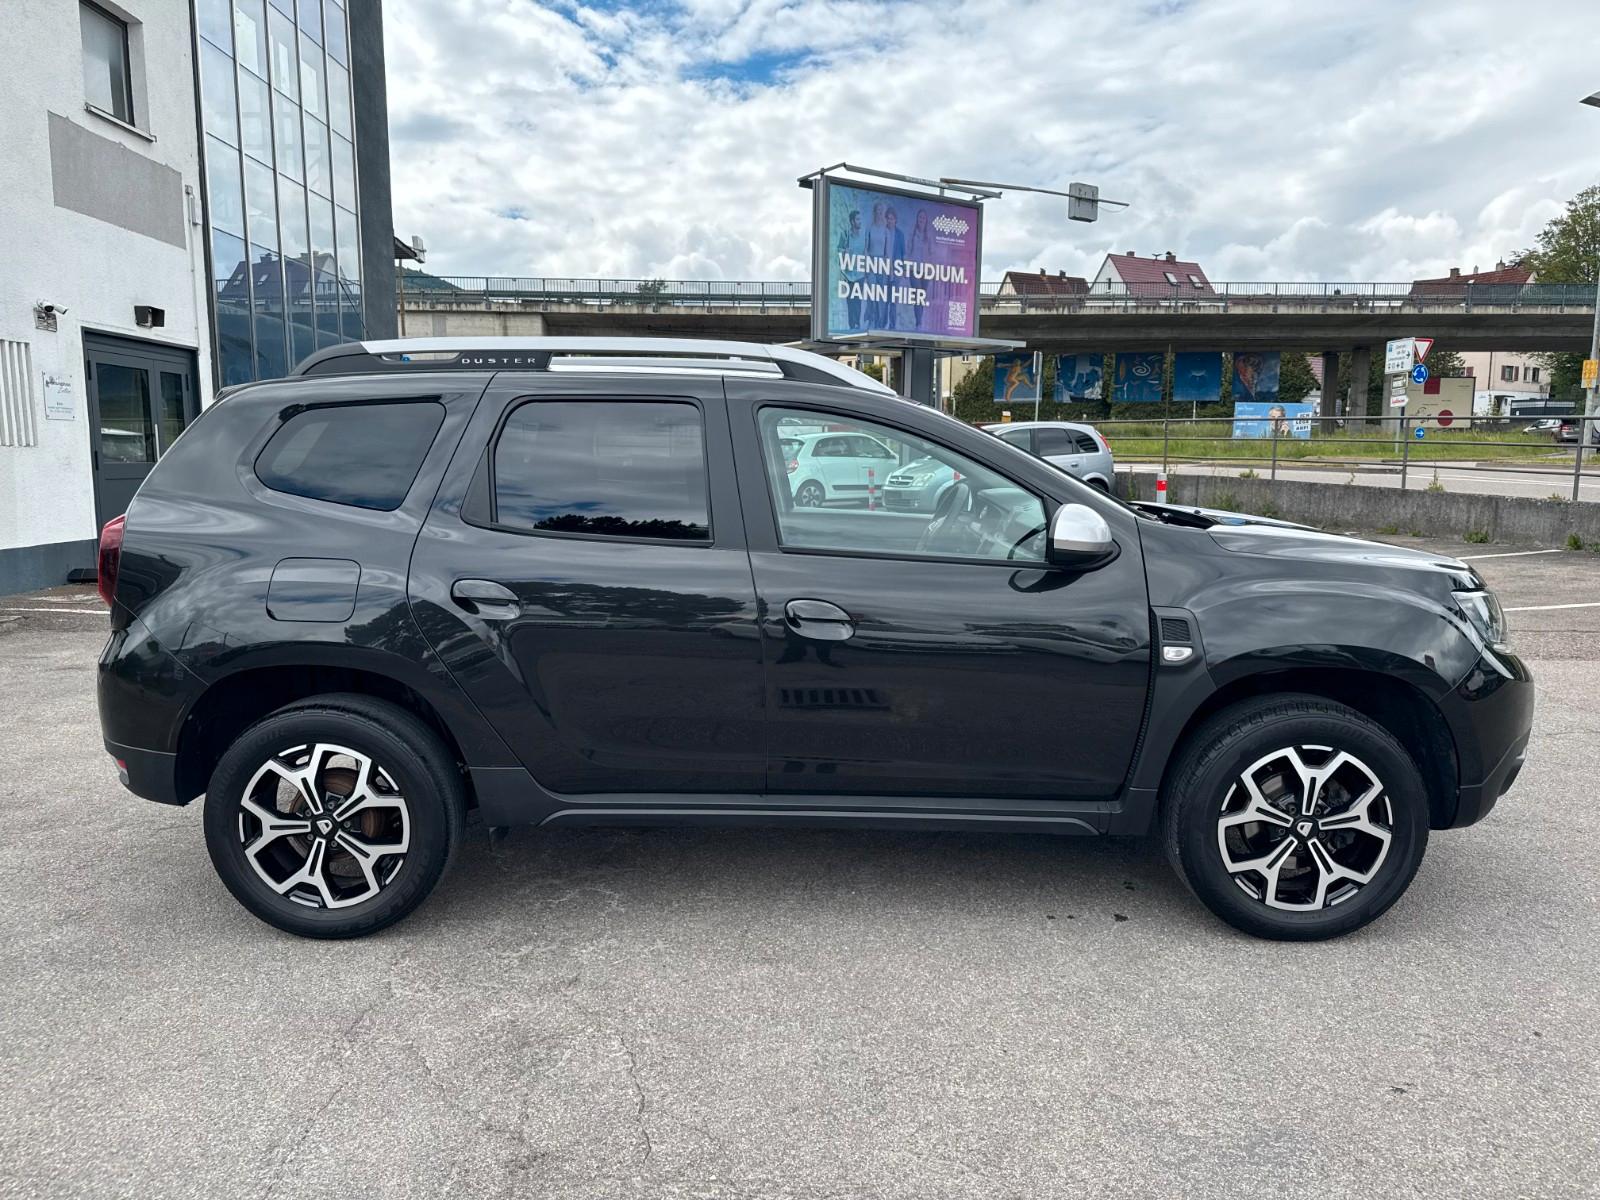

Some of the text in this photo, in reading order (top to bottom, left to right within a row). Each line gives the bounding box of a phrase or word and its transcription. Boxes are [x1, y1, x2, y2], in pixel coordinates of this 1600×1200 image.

[838, 252, 968, 284] WENN STUDIUM.
[838, 280, 930, 306] DANN HIER.
